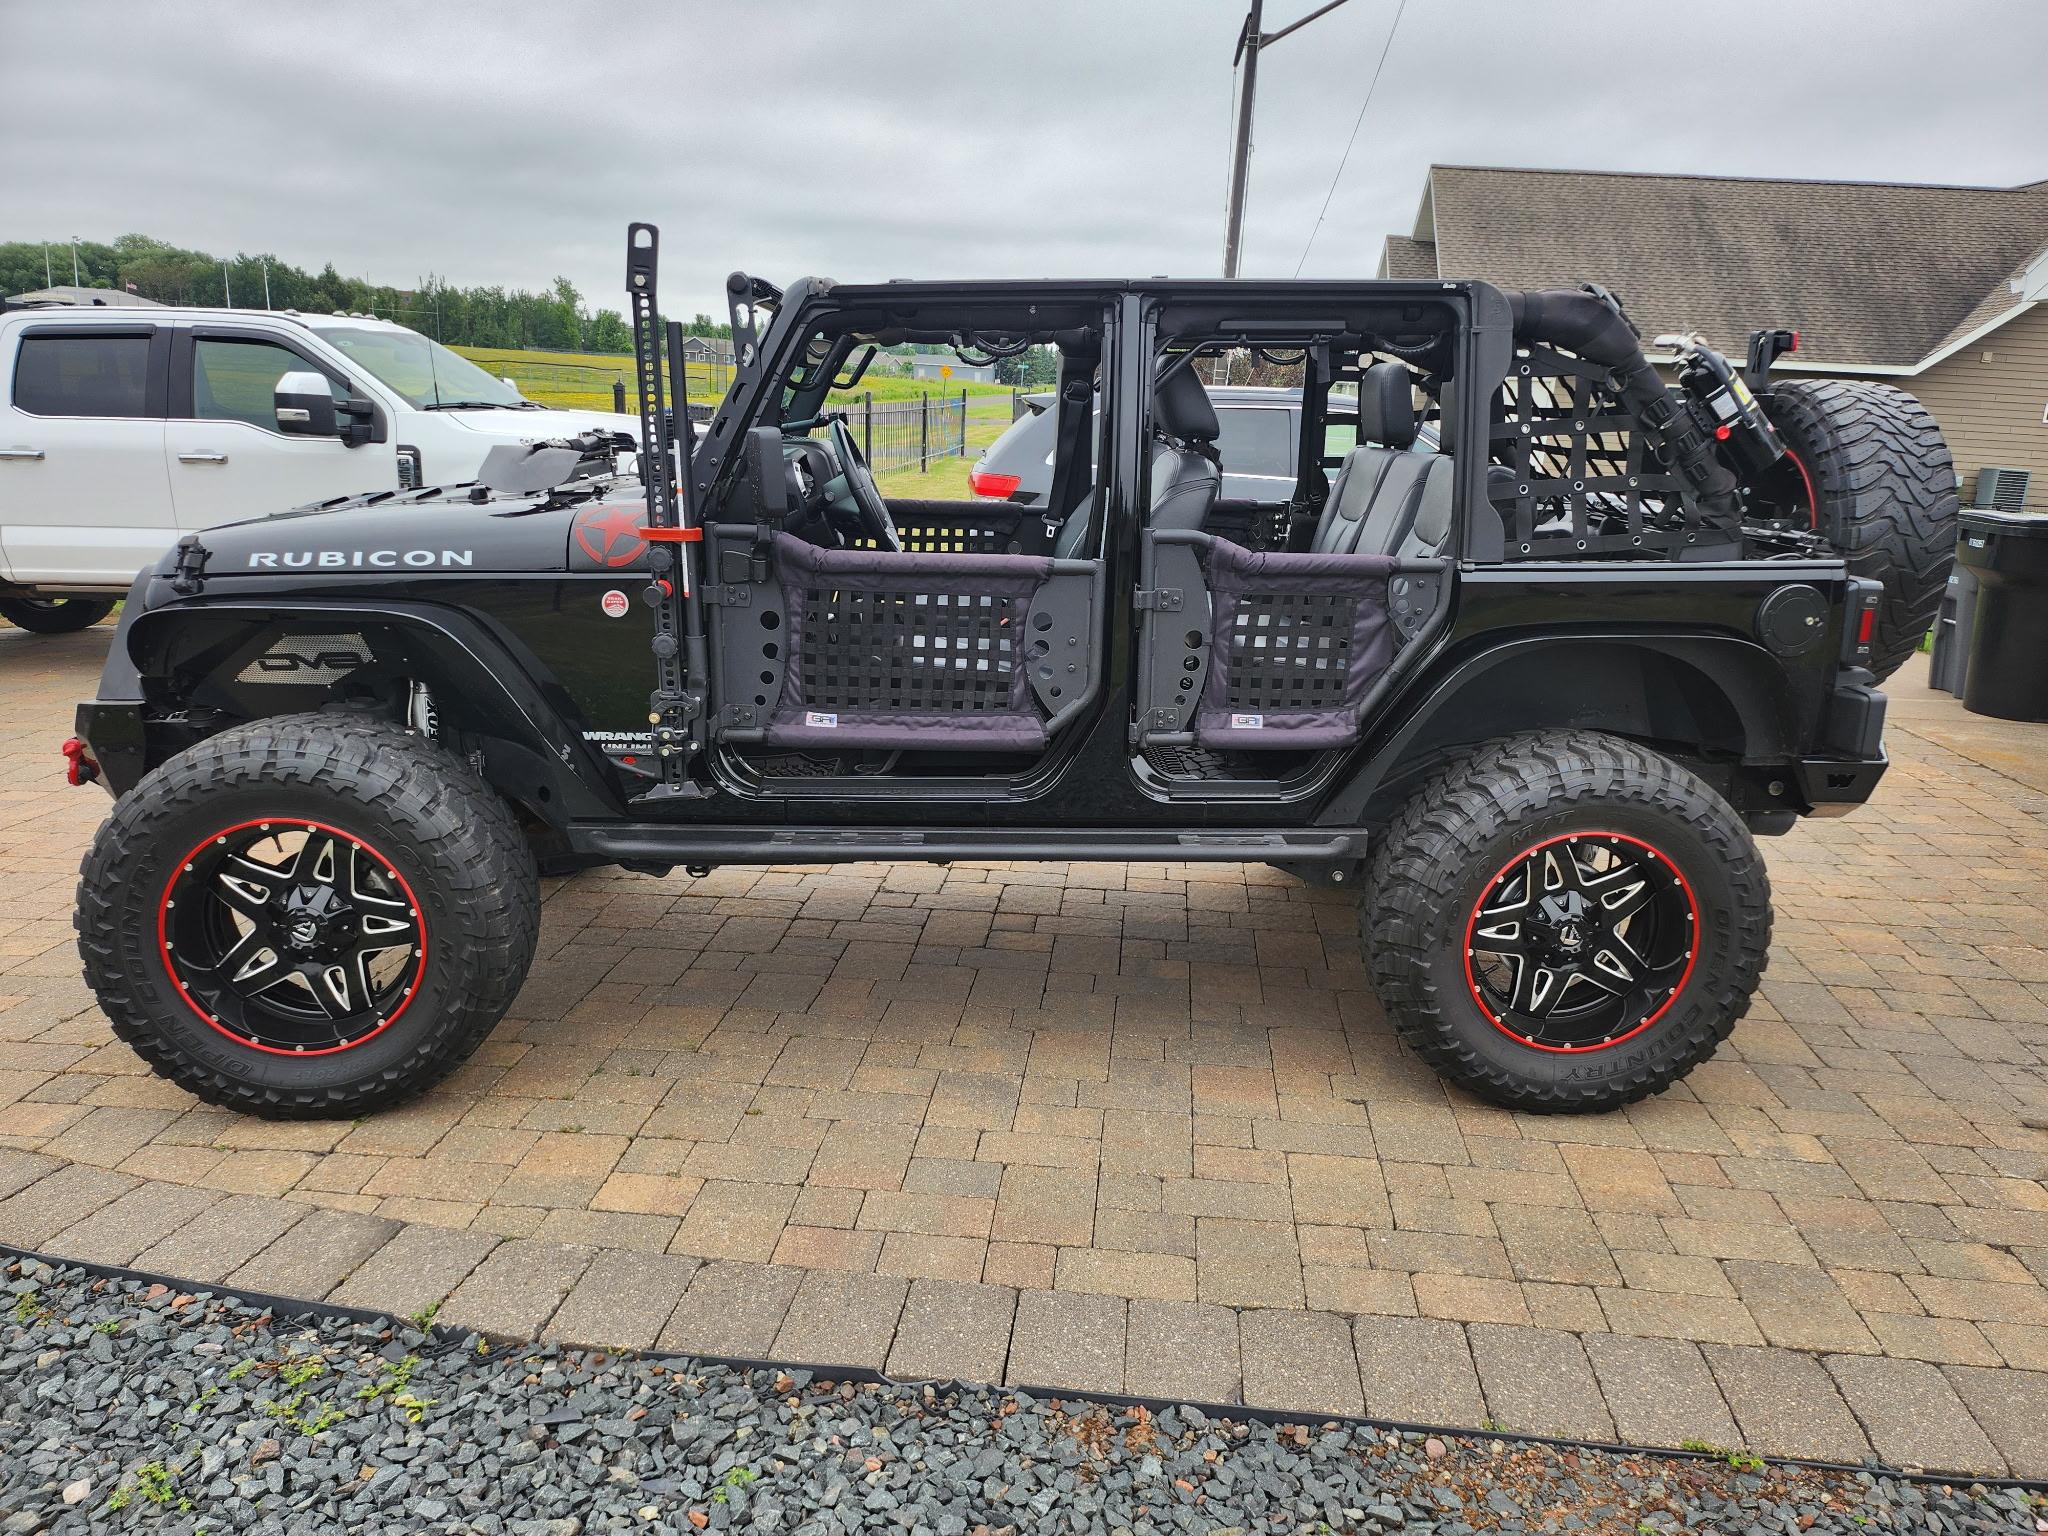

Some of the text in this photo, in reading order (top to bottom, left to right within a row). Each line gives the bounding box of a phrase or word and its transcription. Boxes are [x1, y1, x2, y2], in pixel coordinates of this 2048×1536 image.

[248, 550, 473, 567] RUBICON
[582, 731, 652, 741] WRANG
[602, 743, 653, 751] UNLIMI
[1560, 907, 1730, 1082] OPEN COUNTRY
